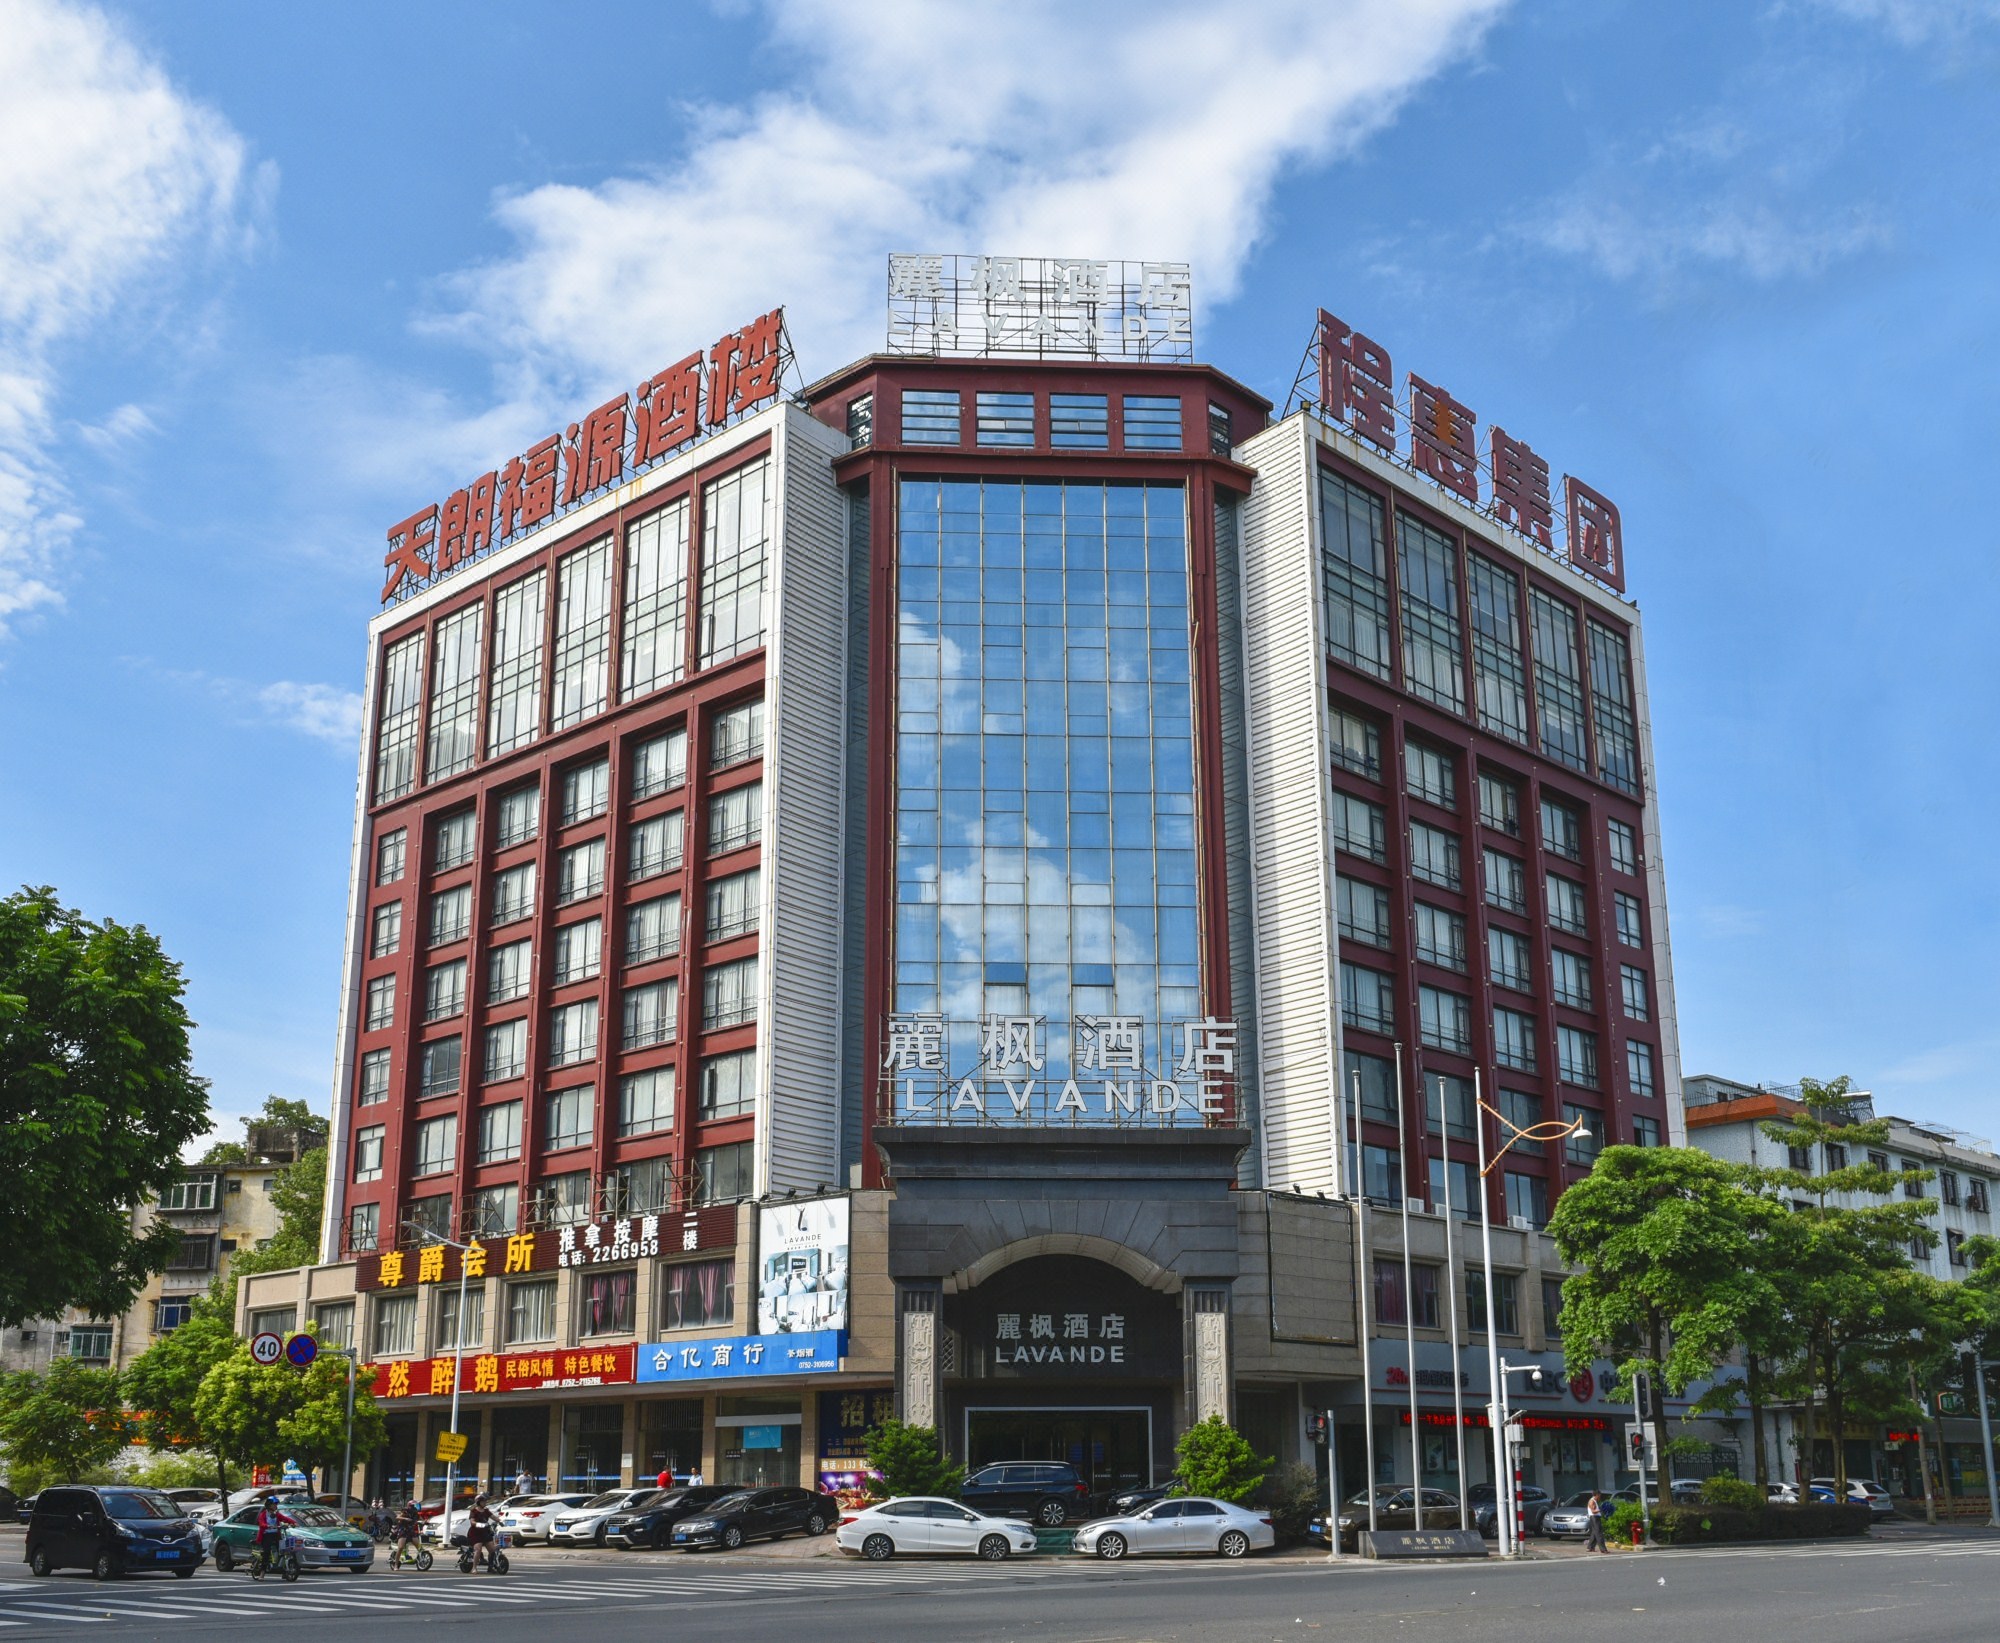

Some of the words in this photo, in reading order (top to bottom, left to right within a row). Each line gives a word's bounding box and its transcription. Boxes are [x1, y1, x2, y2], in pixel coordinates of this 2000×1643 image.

[889, 253, 1190, 309] 麗枫酒店
[887, 308, 1192, 342] LAVANDE
[381, 307, 783, 604] 天朗福源酒楼
[1317, 306, 1626, 594] 程惠集团
[883, 1012, 1238, 1074] 麗枫酒店
[905, 1078, 1226, 1115] LAVANDE
[559, 1215, 659, 1253] 推拿按摩
[683, 1212, 698, 1251] 二楼
[784, 1233, 822, 1245] LAVANDE
[378, 1233, 536, 1287] 尊爵会所
[592, 1239, 659, 1263] 2266958
[996, 1313, 1125, 1340] 麗枫酒店
[257, 1340, 277, 1357] 40
[652, 1343, 765, 1372] 合亿商行
[995, 1345, 1125, 1363] LAVANDE
[361, 1355, 499, 1398] 然醉鹅
[505, 1358, 555, 1379] 民俗风情
[564, 1354, 617, 1375] 特色餐饮
